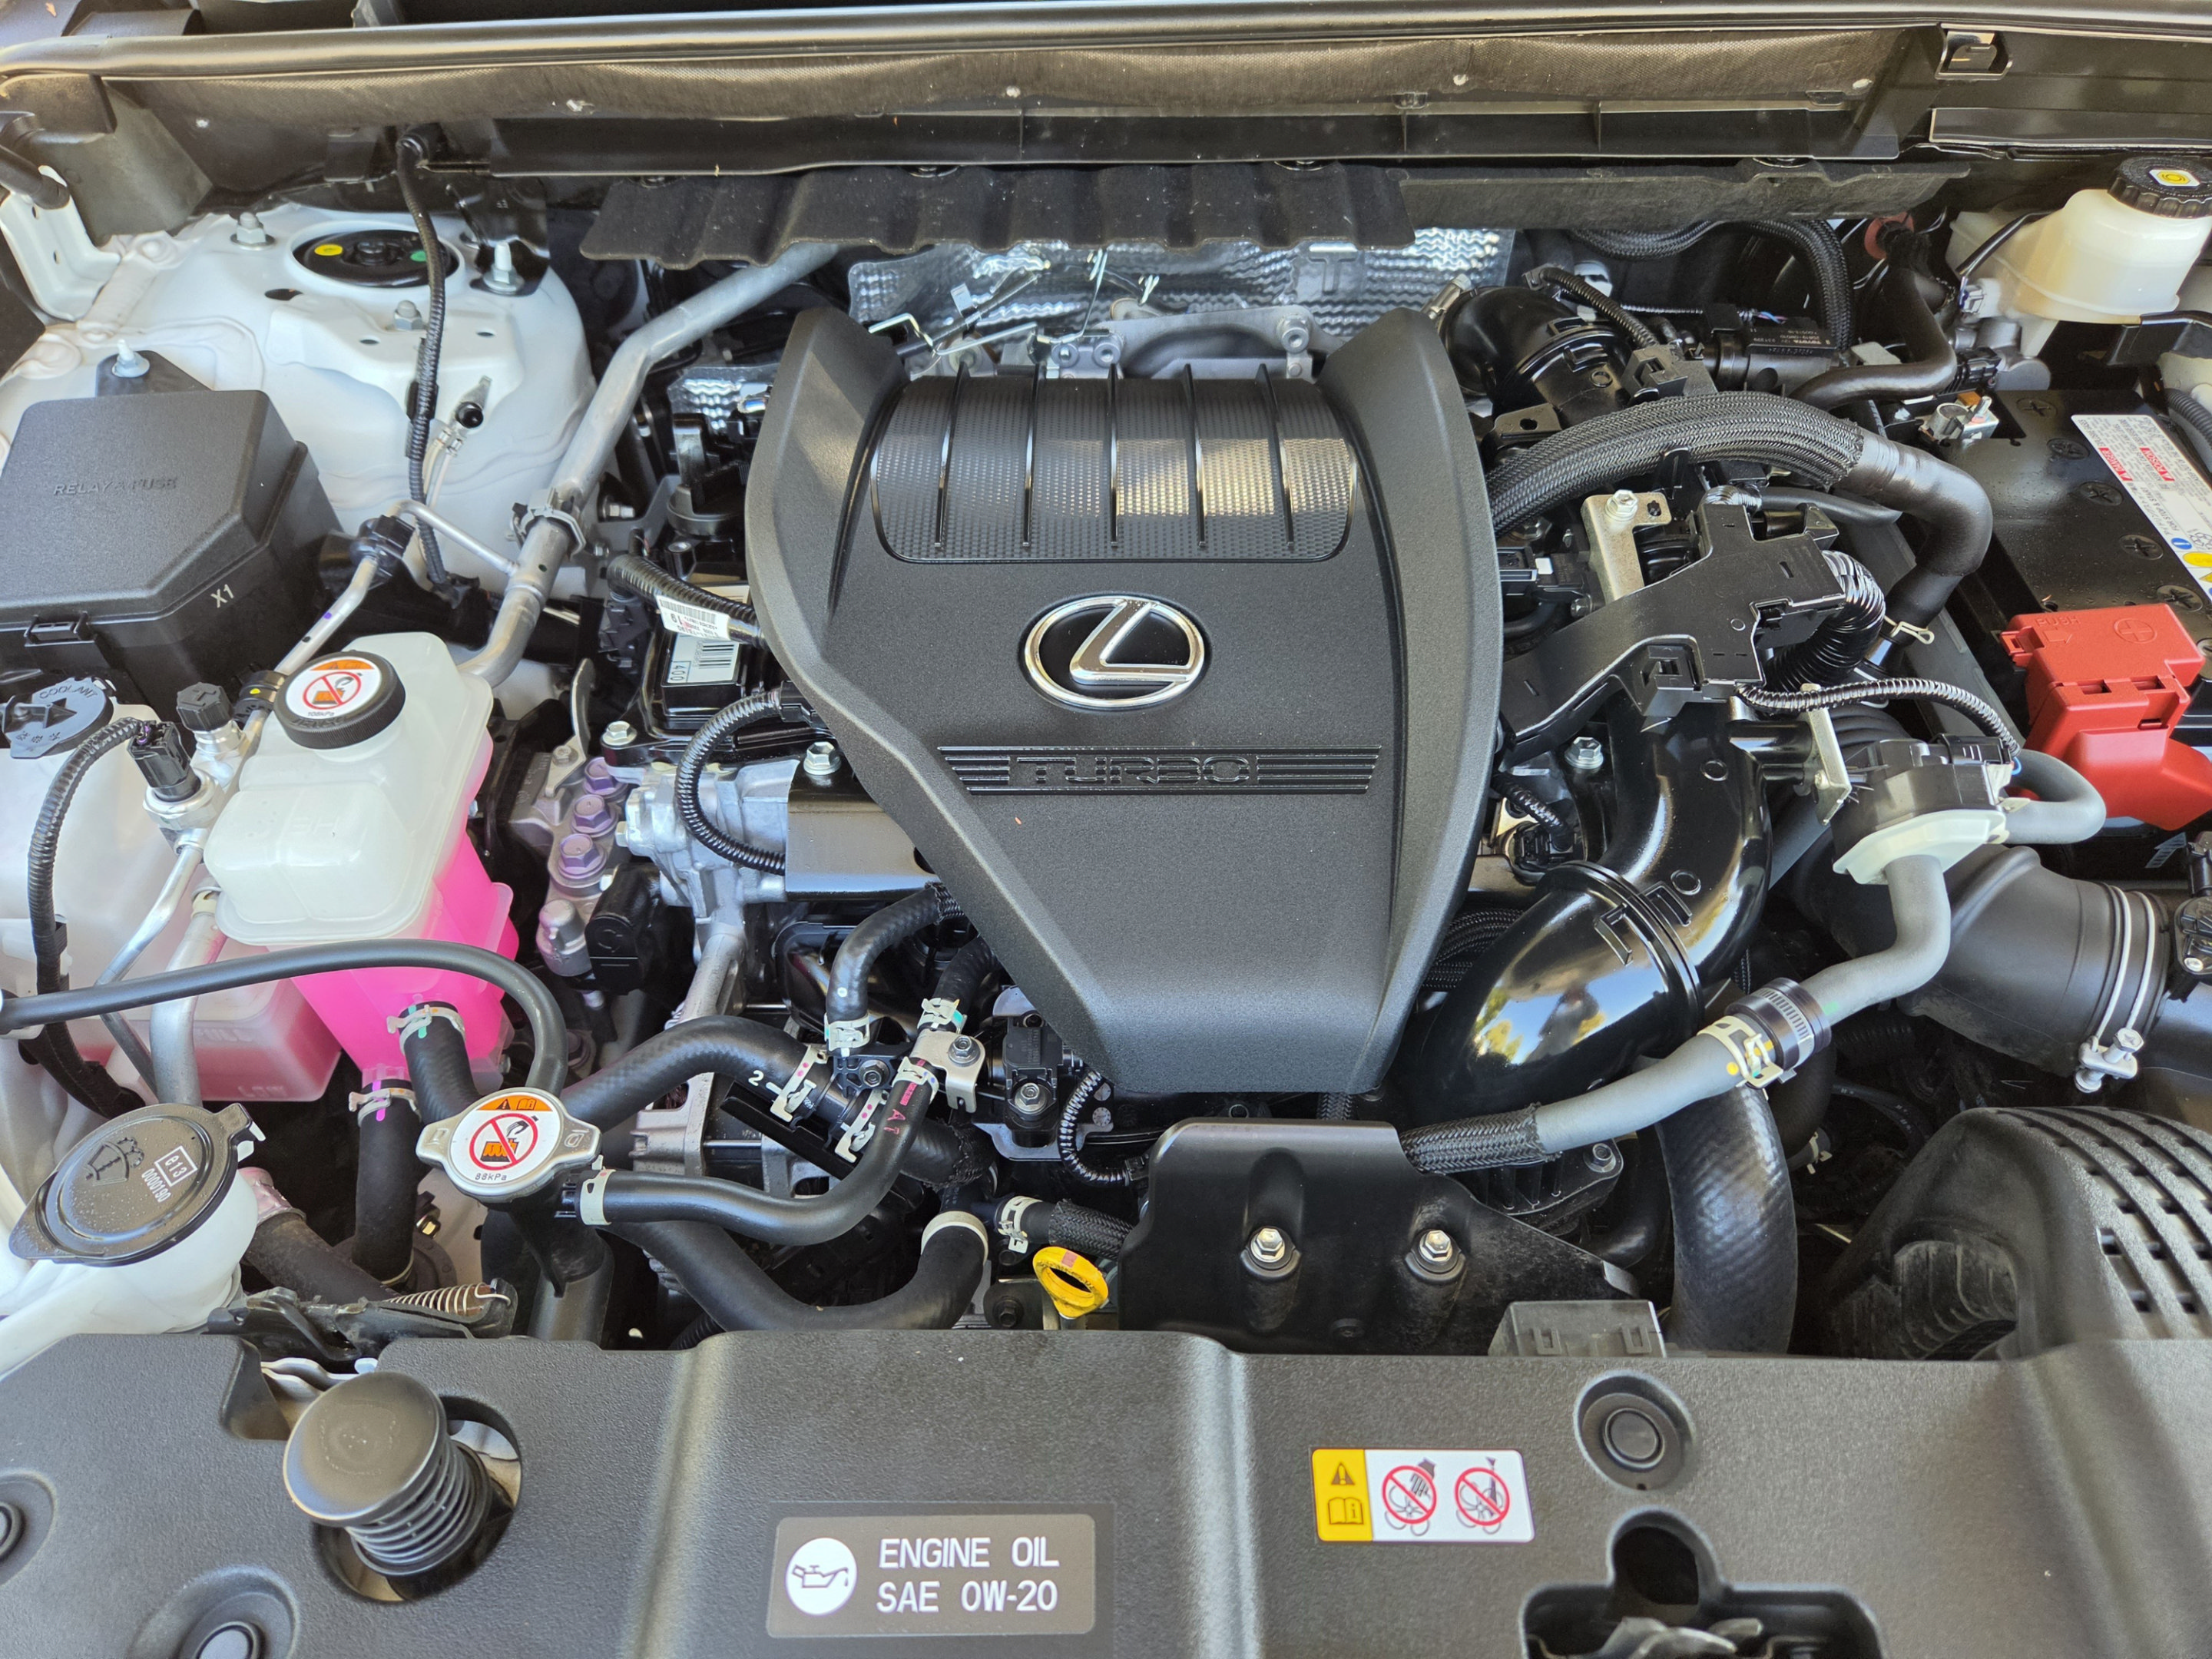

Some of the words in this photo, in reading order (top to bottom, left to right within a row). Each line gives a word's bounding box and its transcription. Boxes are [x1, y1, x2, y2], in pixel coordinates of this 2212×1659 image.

[2141, 450, 2167, 471] POISON
[53, 481, 114, 496] RELAY
[2139, 487, 2157, 501] START
[2154, 507, 2171, 519] STOP
[210, 584, 234, 608] X1
[2036, 616, 2081, 628] PUSH
[670, 664, 687, 681] 400
[39, 684, 98, 699] COOLANT
[1016, 757, 1250, 785] TURBO
[164, 1154, 187, 1178] e13
[141, 1167, 171, 1204] 0000190
[474, 1172, 507, 1181] 88kPa
[879, 1537, 991, 1568] ENGINE
[1012, 1536, 1060, 1567] OIL
[876, 1581, 940, 1613] SAE
[961, 1579, 1058, 1612] 0W-20
